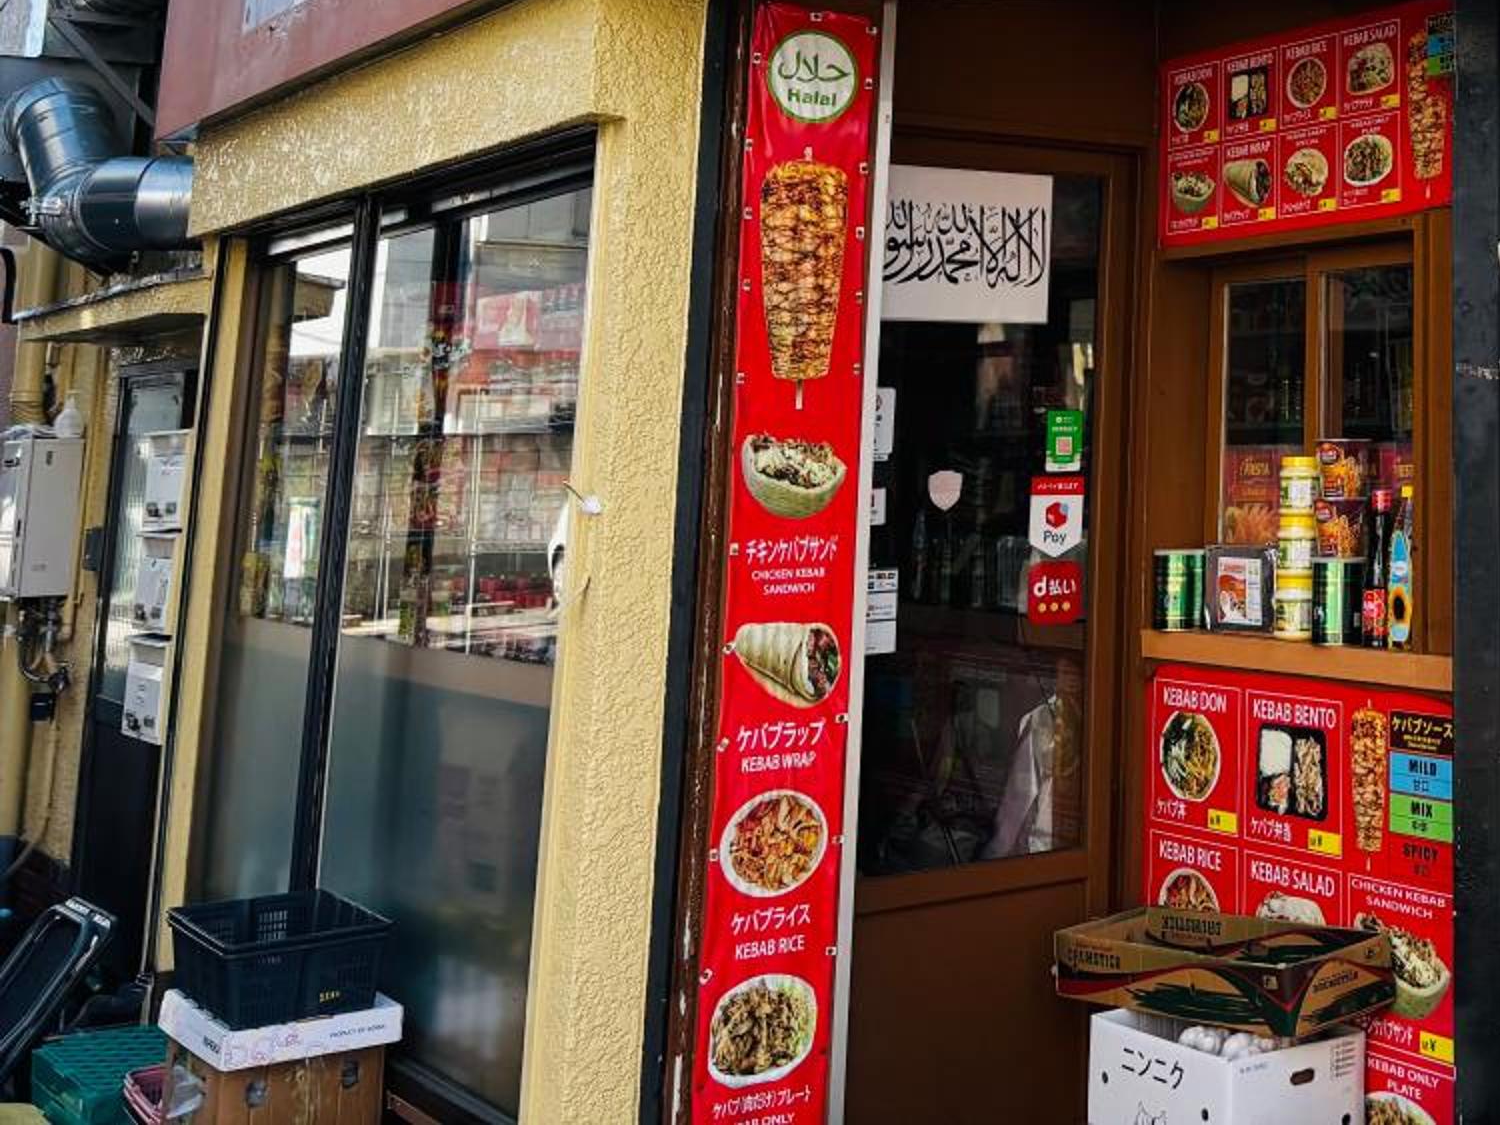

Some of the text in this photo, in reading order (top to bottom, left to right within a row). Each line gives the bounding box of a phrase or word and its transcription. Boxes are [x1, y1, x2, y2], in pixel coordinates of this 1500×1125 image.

[778, 49, 851, 84] حلال
[788, 88, 836, 107] Halal
[745, 534, 839, 565] チキンケバブサンド
[1043, 530, 1068, 545] Pay
[751, 567, 826, 582] CHICKEN KEBAB
[1033, 576, 1076, 597] d払い
[762, 583, 816, 596] SANDWICH
[1163, 686, 1227, 713] KEBAB DON
[1253, 699, 1338, 729] KEBAB BENTO
[1391, 714, 1454, 738] ケバブソース
[735, 718, 826, 753] ケバブラップ
[741, 751, 817, 773] KEBAB WRAP
[1408, 759, 1438, 777] MILD
[1410, 801, 1433, 819] MIX
[1159, 839, 1222, 872] KEBAB RICE
[1250, 859, 1335, 898] KEBAB SALAD
[1351, 879, 1446, 908] CHICKEN KEBAB
[731, 903, 812, 935] ケバブライス
[1365, 895, 1434, 920] SANDWICH
[735, 934, 806, 961] KEBAB RICE
[1121, 1047, 1185, 1090] ニンニク
[1367, 1056, 1407, 1079] KEBAB
[1407, 1067, 1440, 1088] ONLY
[1386, 1079, 1422, 1100] PLATE
